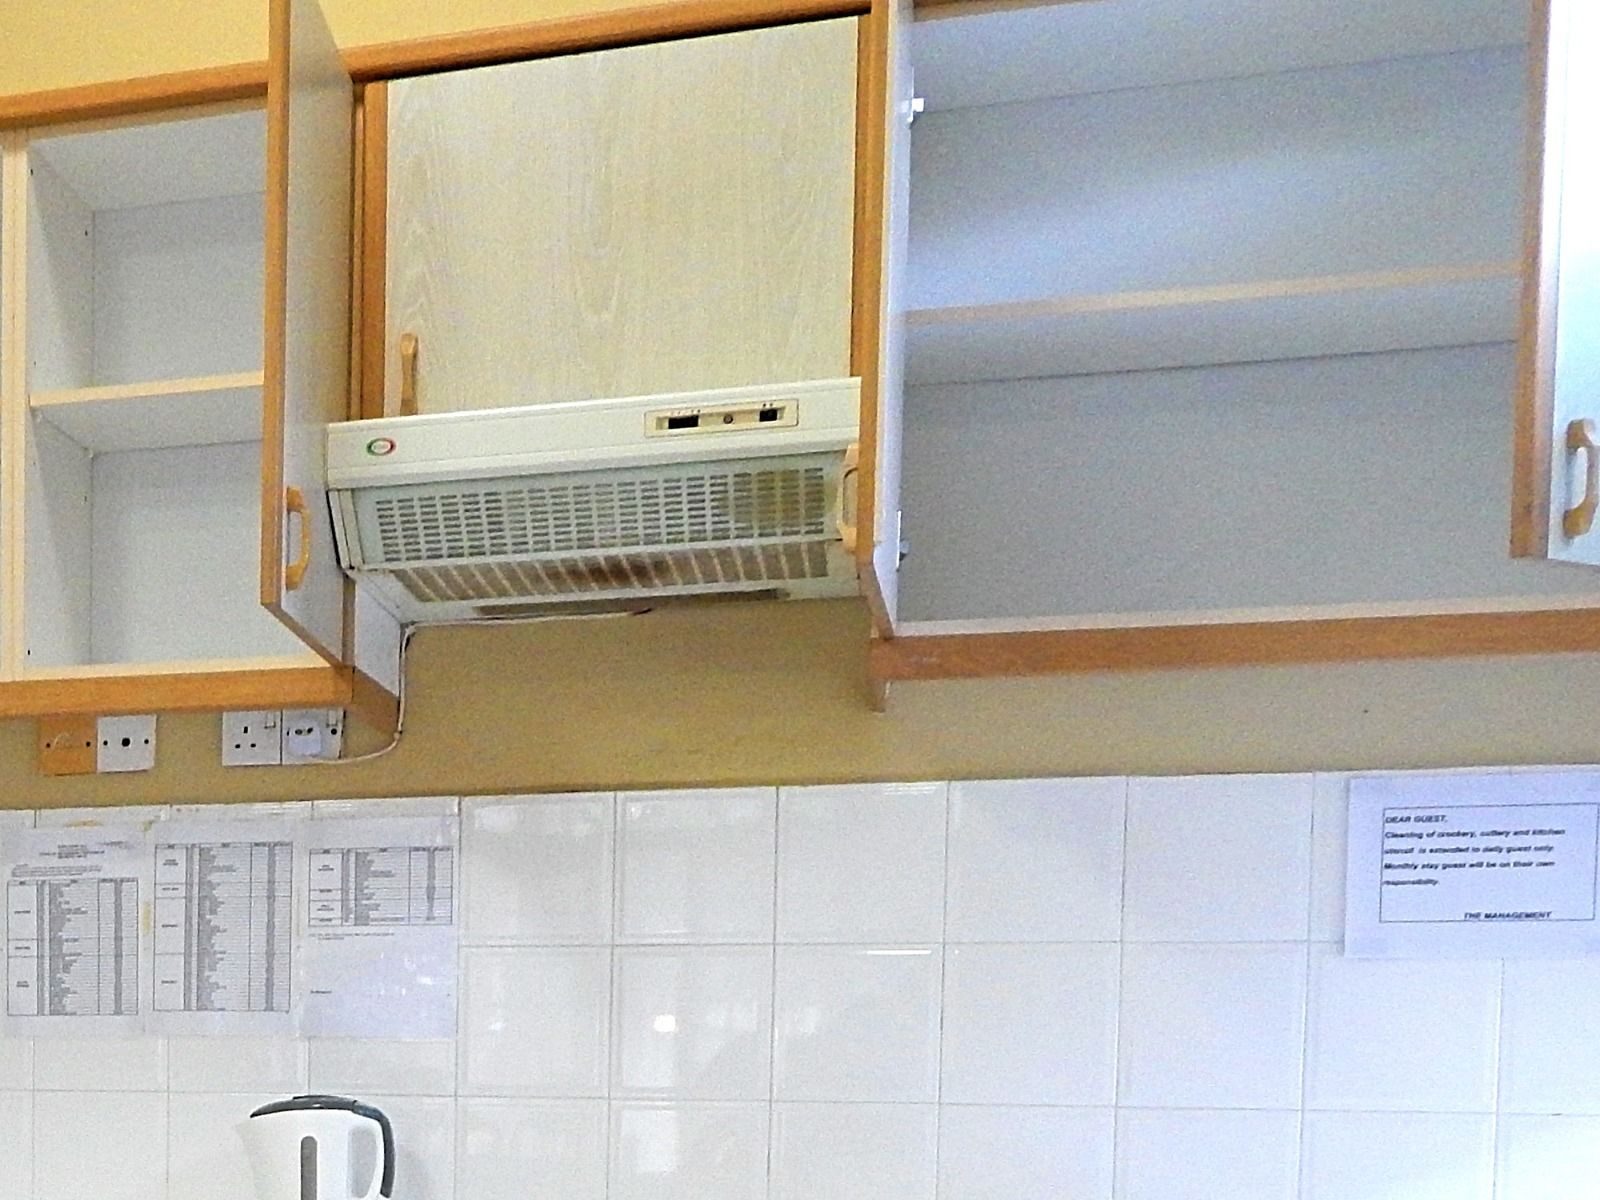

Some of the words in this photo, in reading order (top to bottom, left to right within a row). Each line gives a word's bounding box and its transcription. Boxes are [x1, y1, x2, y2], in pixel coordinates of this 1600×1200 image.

[1384, 815, 1412, 824] DEAR
[1425, 830, 1436, 838] of
[1420, 862, 1440, 870] stay
[1468, 861, 1485, 869] will
[1463, 912, 1483, 920] THE
[1483, 910, 1554, 919] MANAGEMENT
